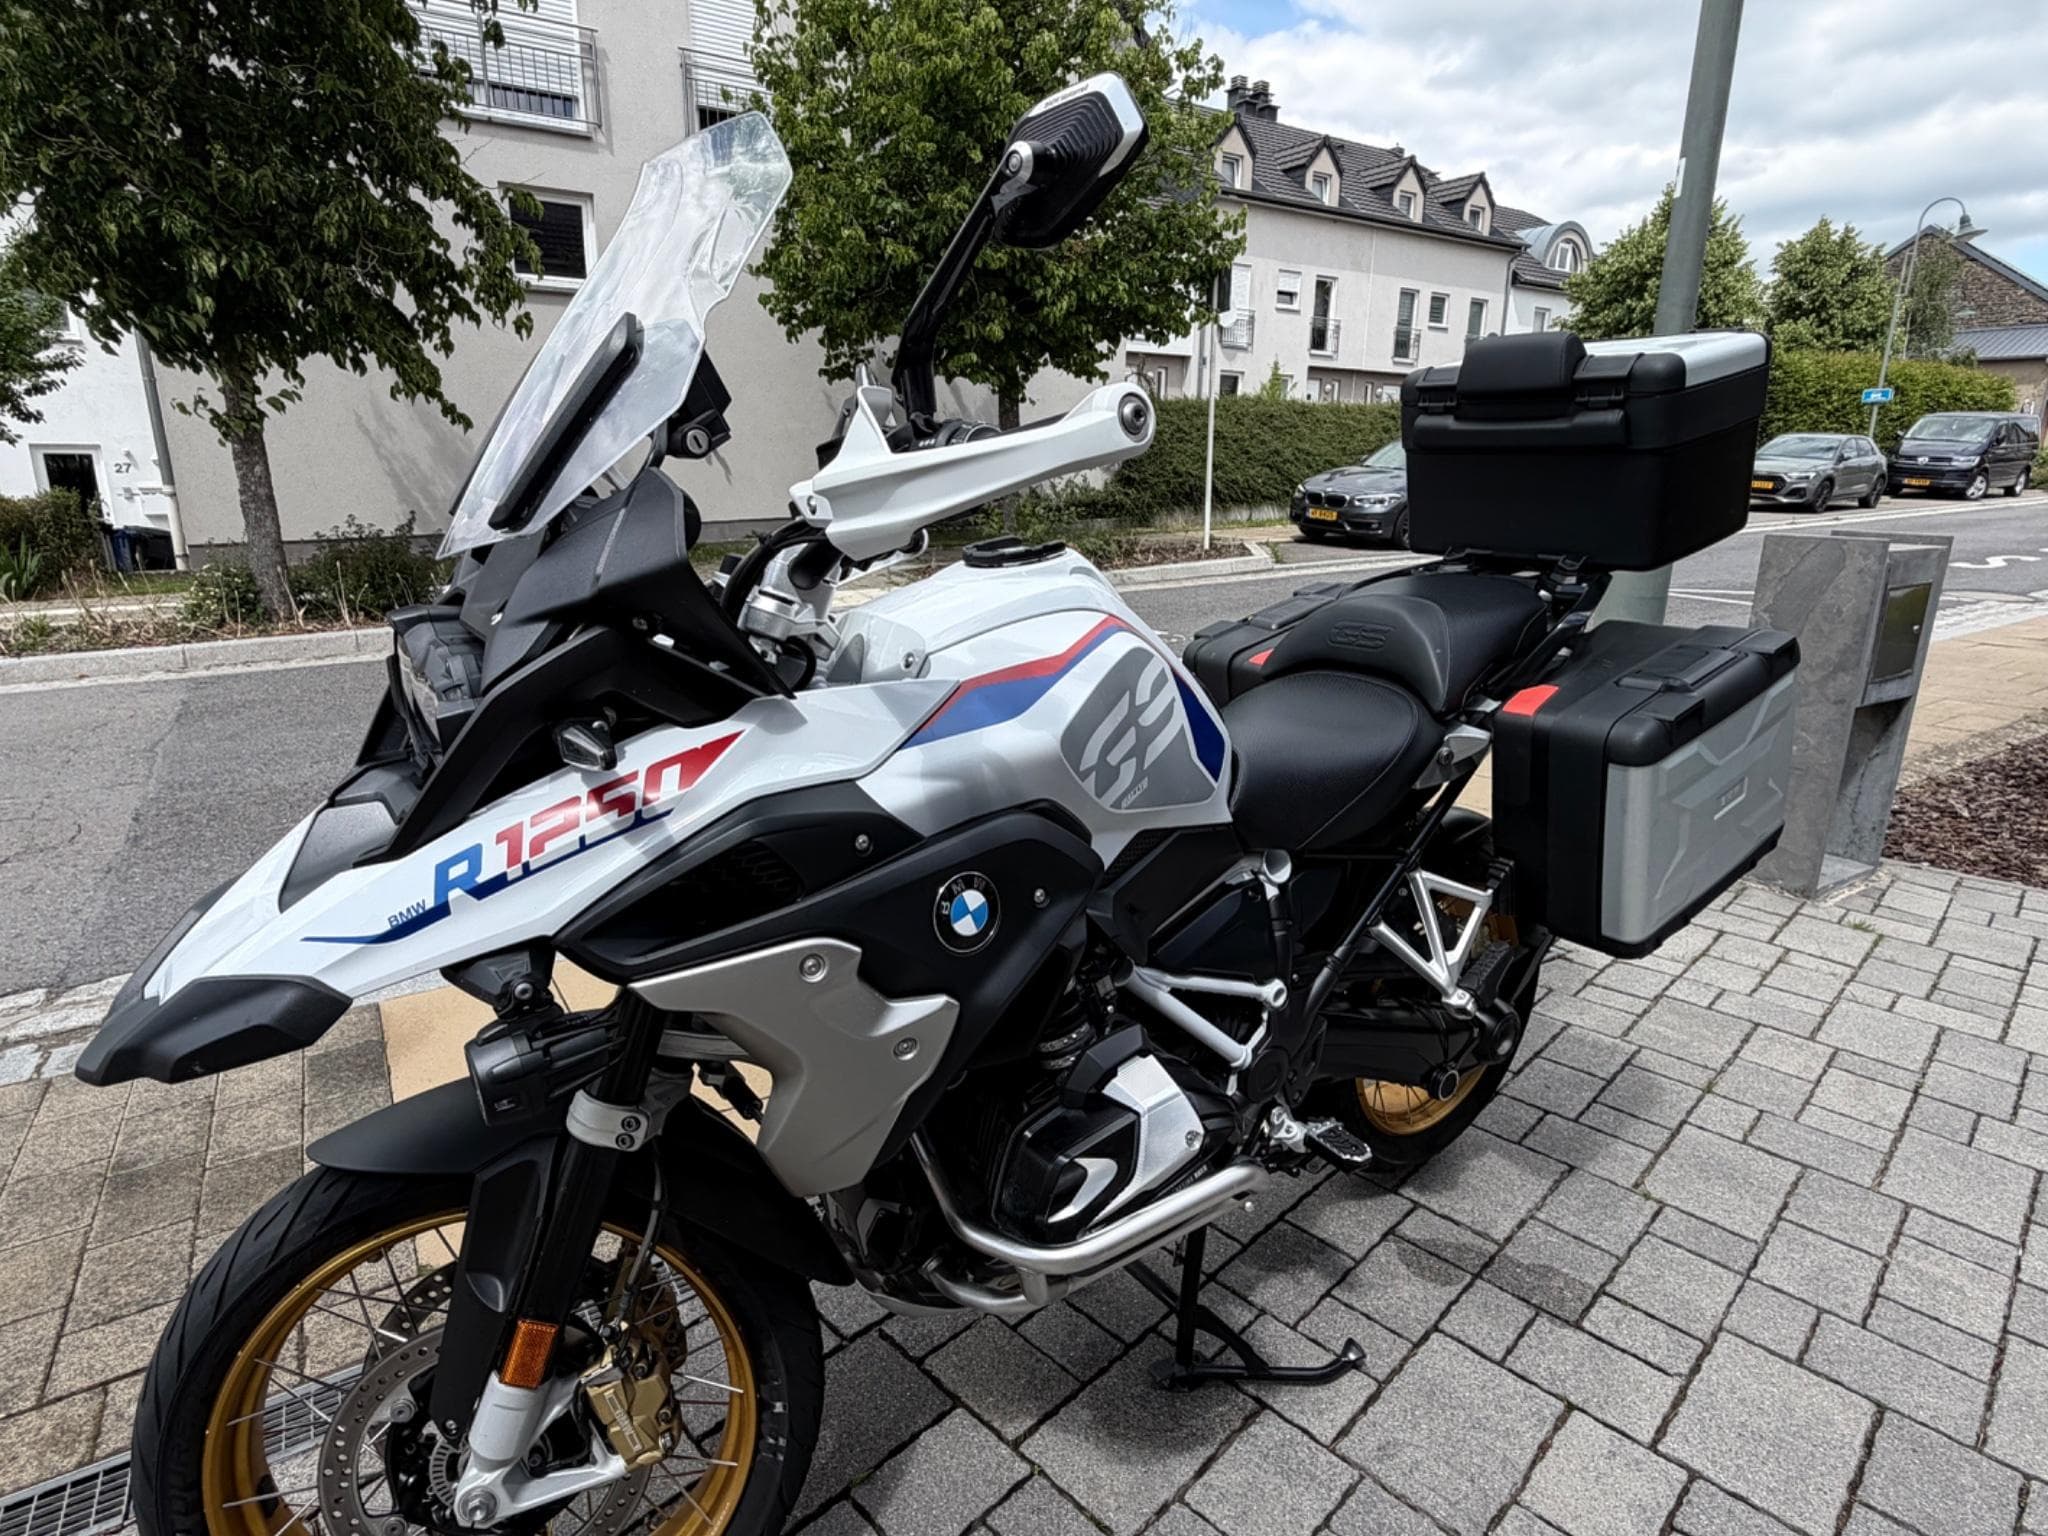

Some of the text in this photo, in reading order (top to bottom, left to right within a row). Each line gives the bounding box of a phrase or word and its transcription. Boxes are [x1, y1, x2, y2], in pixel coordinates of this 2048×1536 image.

[114, 462, 131, 474] 27
[433, 842, 486, 915] R
[387, 899, 428, 929] BMW
